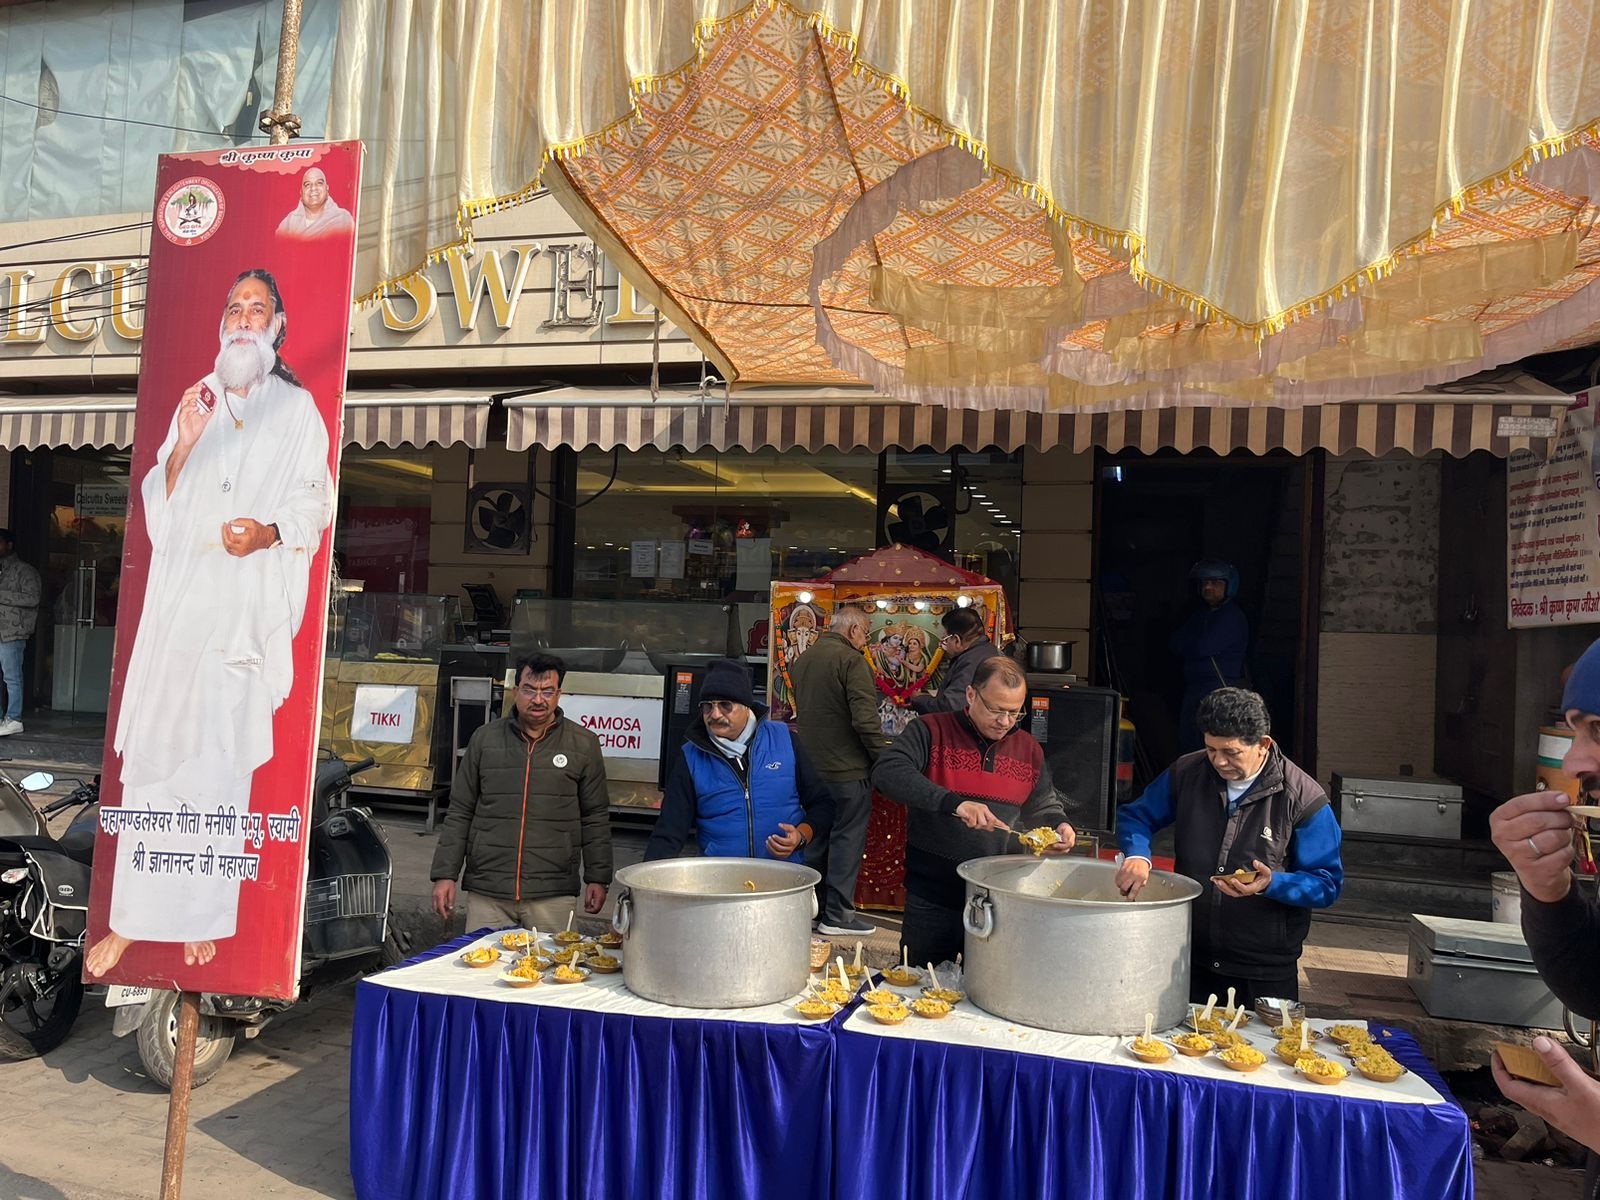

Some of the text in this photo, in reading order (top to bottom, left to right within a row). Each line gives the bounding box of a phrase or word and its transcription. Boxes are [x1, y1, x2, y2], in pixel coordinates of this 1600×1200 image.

[221, 148, 312, 164] श्री कृष्ण कृपा
[0, 261, 148, 344] LCU
[370, 712, 401, 727] TIKKI
[580, 714, 641, 732] SAMOSA
[597, 733, 641, 749] CHORI
[100, 803, 173, 835] महामण्डलेश्वर
[176, 803, 201, 834] गीता
[204, 805, 237, 836] मनीषी
[267, 806, 301, 841] स्वामी
[132, 841, 259, 881] श्री ज्ञानानन्द जी महाराज
